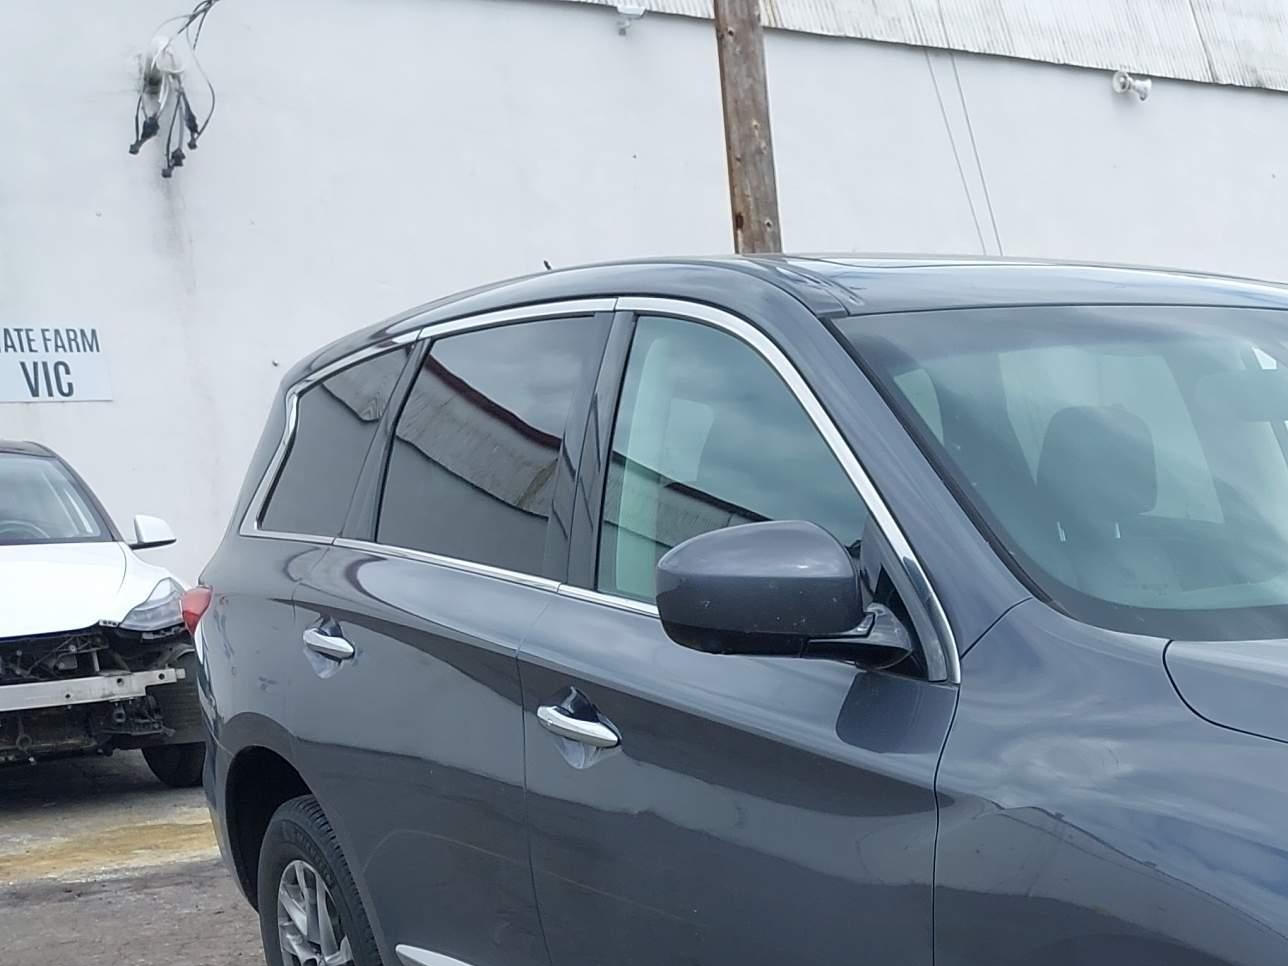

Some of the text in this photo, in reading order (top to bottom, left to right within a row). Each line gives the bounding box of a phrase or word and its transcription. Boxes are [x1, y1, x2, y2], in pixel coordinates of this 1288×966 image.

[0, 328, 100, 352] ATE FARM
[20, 361, 74, 397] VIC
